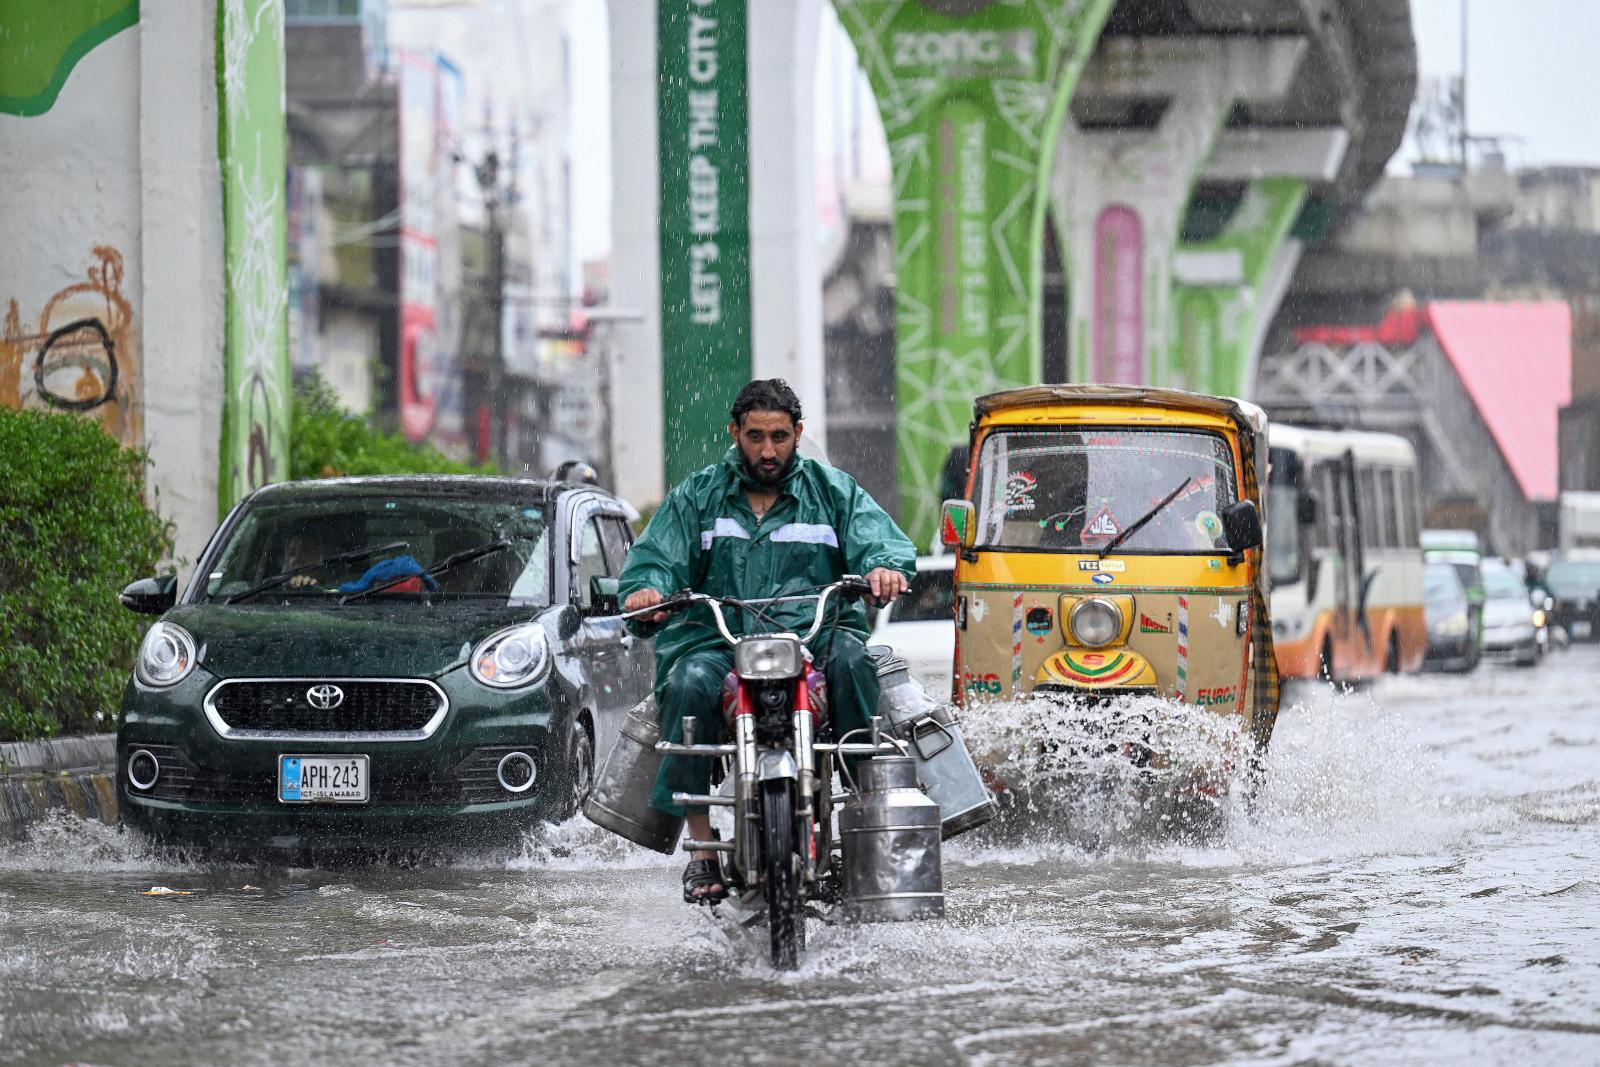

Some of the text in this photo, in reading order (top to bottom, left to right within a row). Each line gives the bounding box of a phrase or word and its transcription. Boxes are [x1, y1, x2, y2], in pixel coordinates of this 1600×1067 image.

[687, 14, 719, 83] CITY
[687, 90, 720, 150] THE
[687, 155, 720, 235] KEEP
[687, 242, 721, 325] LET'S
[1079, 561, 1099, 570] TEZ
